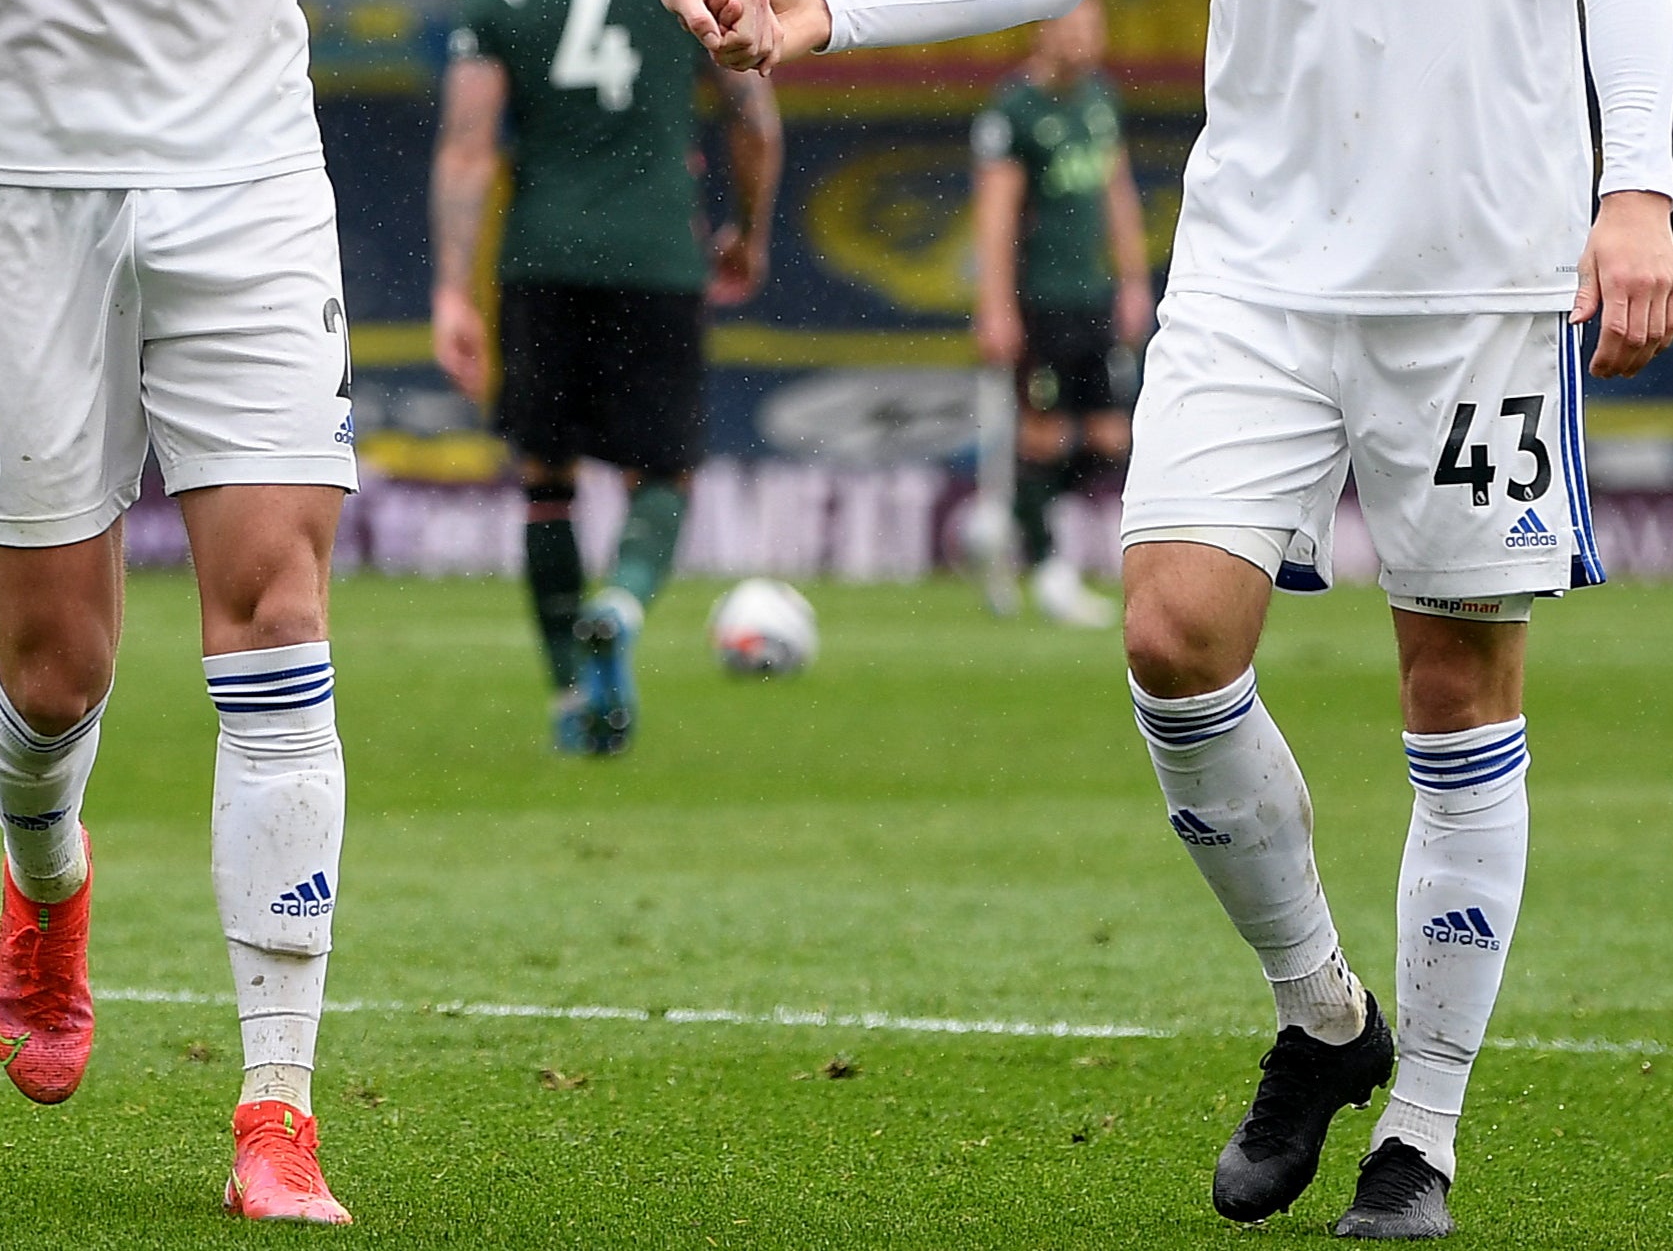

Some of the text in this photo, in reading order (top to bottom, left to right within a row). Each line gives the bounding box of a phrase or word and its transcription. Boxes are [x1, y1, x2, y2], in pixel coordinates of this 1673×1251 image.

[1433, 394, 1553, 507] 43
[1505, 530, 1558, 548] adidas
[1422, 922, 1501, 952] adidas
